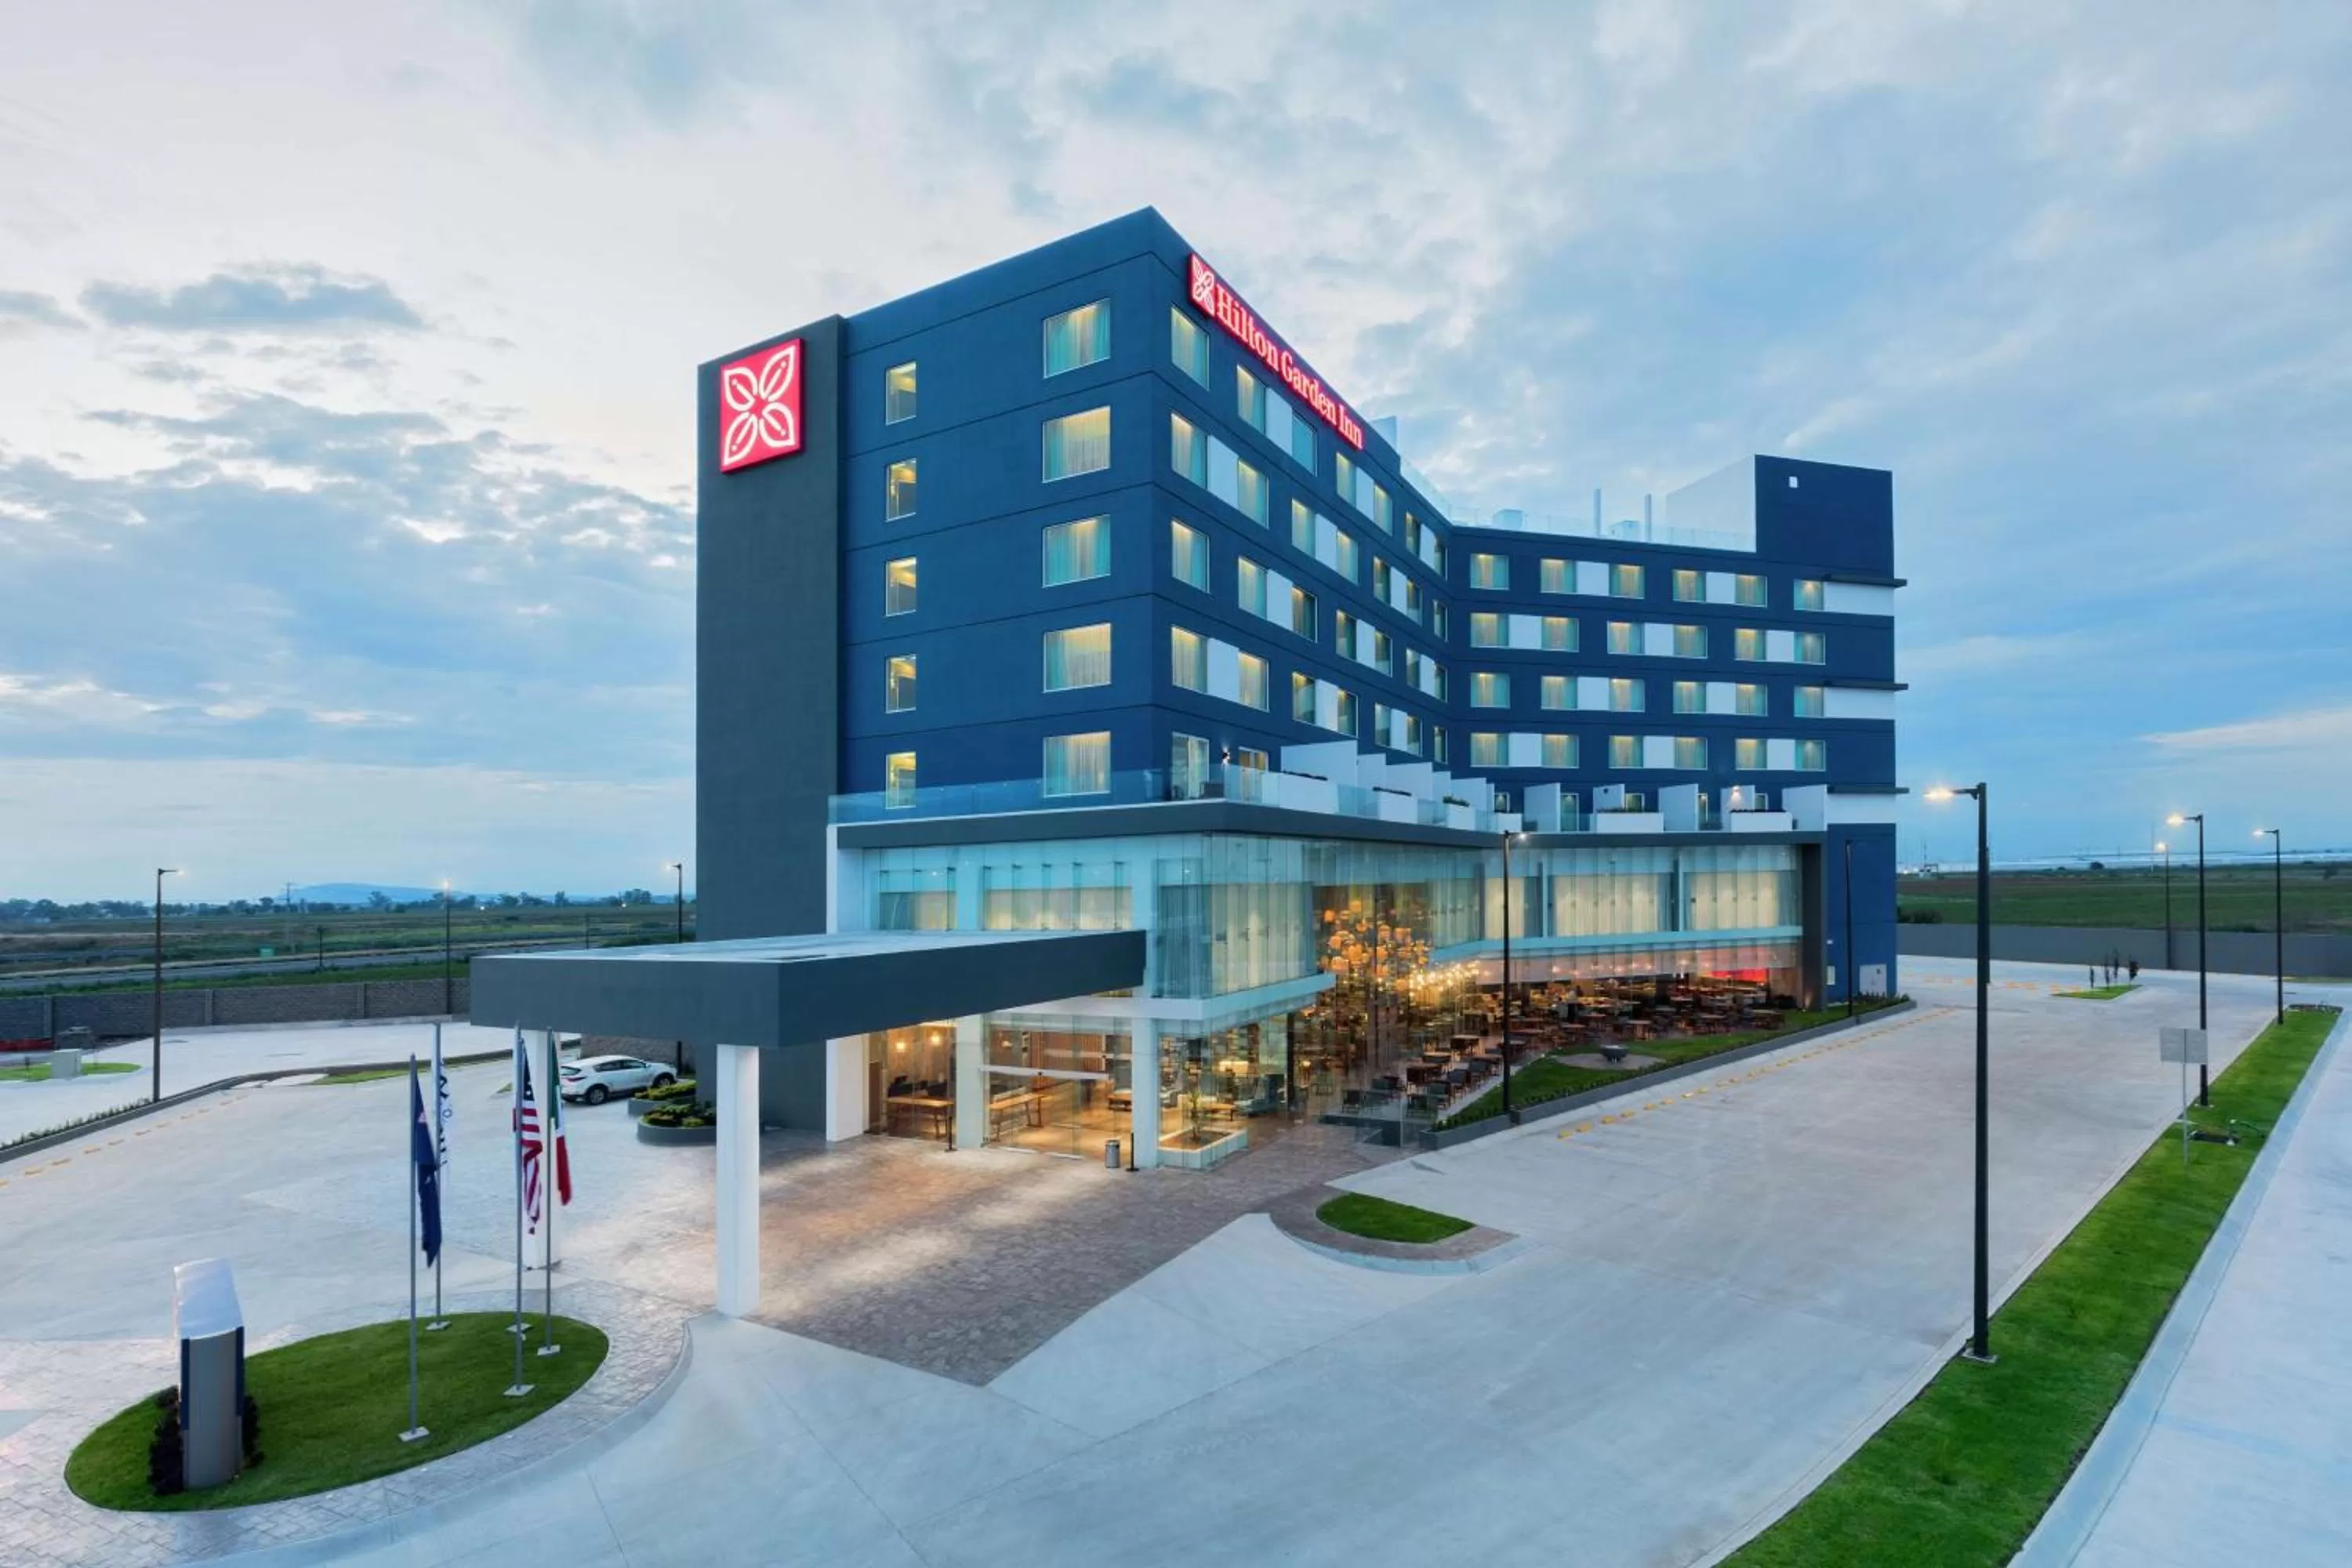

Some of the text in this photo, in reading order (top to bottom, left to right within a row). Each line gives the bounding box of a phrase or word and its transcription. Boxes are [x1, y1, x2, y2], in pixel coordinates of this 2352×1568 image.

[1215, 284, 1363, 450] Hilton Garden Inn
